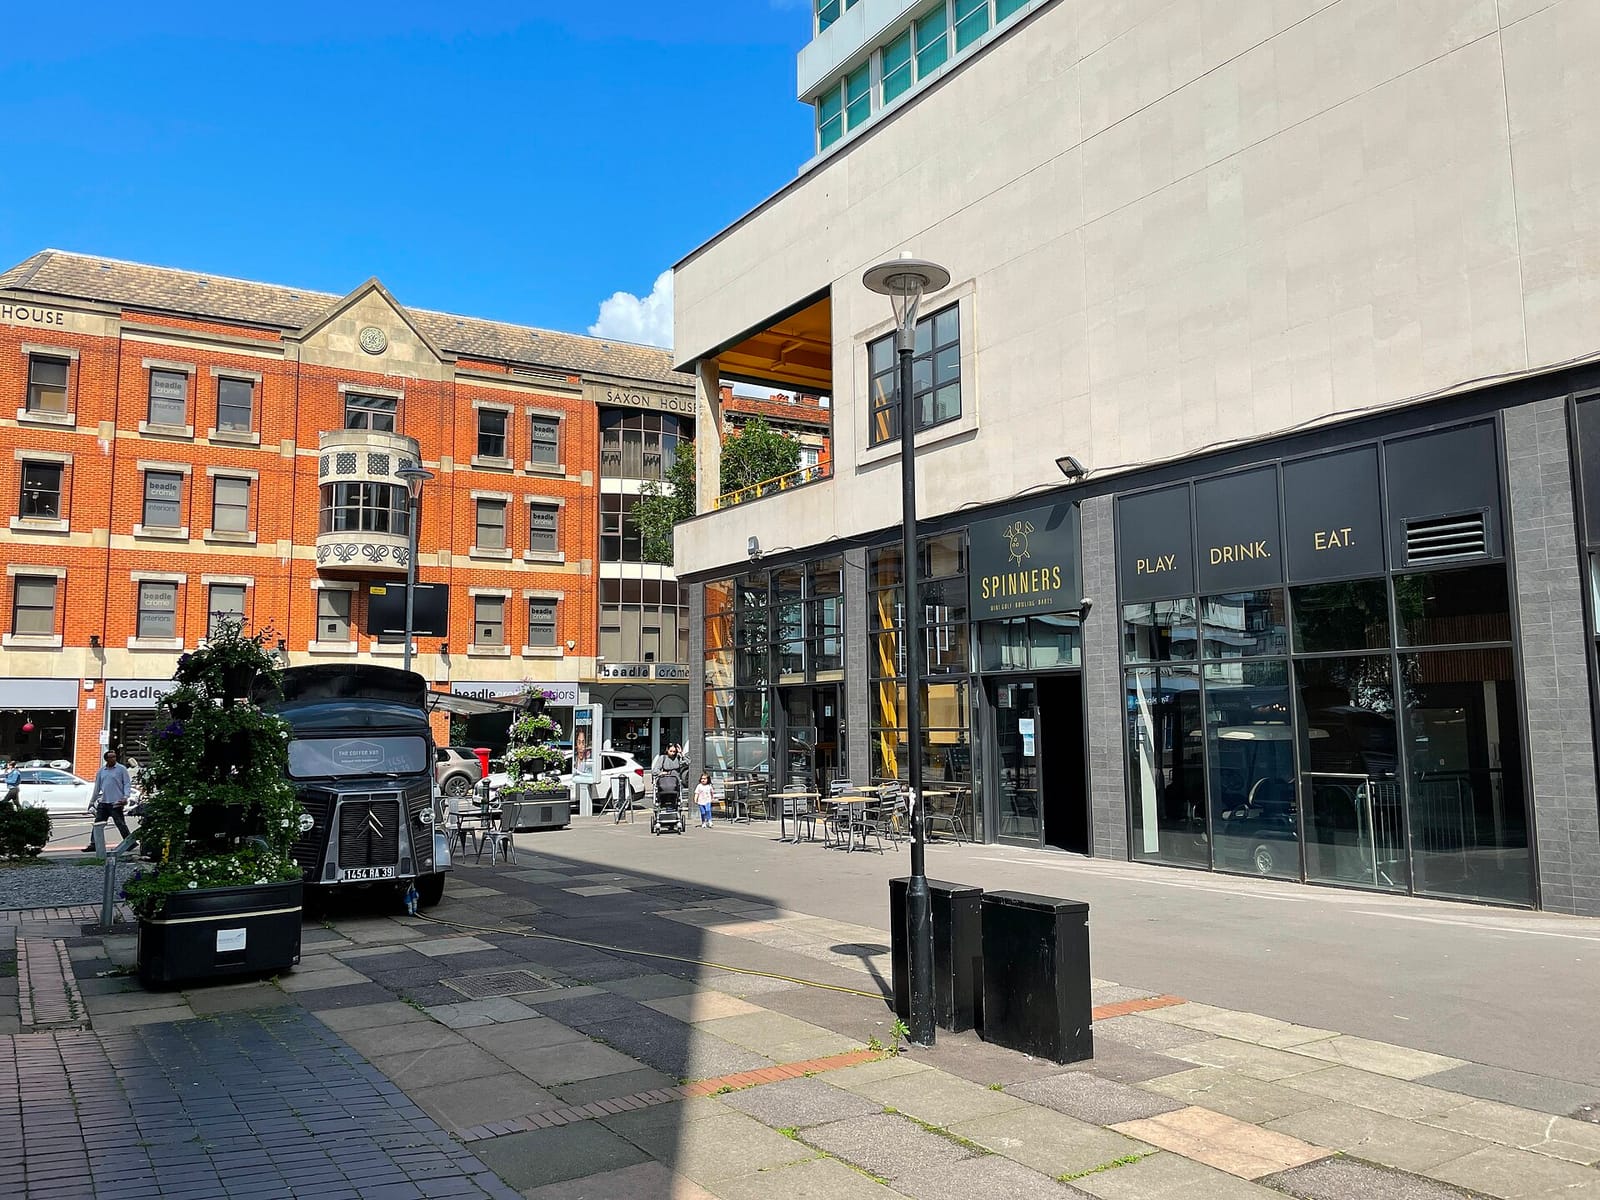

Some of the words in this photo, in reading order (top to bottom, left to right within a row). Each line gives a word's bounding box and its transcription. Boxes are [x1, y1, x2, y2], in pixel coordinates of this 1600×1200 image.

[2, 305, 64, 326] HOUSE
[154, 380, 182, 389] beadle
[607, 391, 650, 407] SAXON
[534, 425, 555, 434] beadle
[149, 482, 178, 491] beadle
[532, 512, 554, 521] beadle
[1314, 528, 1355, 551] EAT.
[1210, 540, 1271, 565] DRINK.
[1137, 554, 1177, 575] PLAY.
[982, 565, 1061, 599] SPINNERS
[143, 592, 172, 600] beadle
[531, 607, 553, 615] beadle
[604, 666, 649, 677] beadle
[659, 668, 689, 677] crome
[110, 686, 162, 699] beadle
[346, 869, 367, 880] 1454
[369, 868, 380, 878] RA
[382, 867, 392, 877] 39
